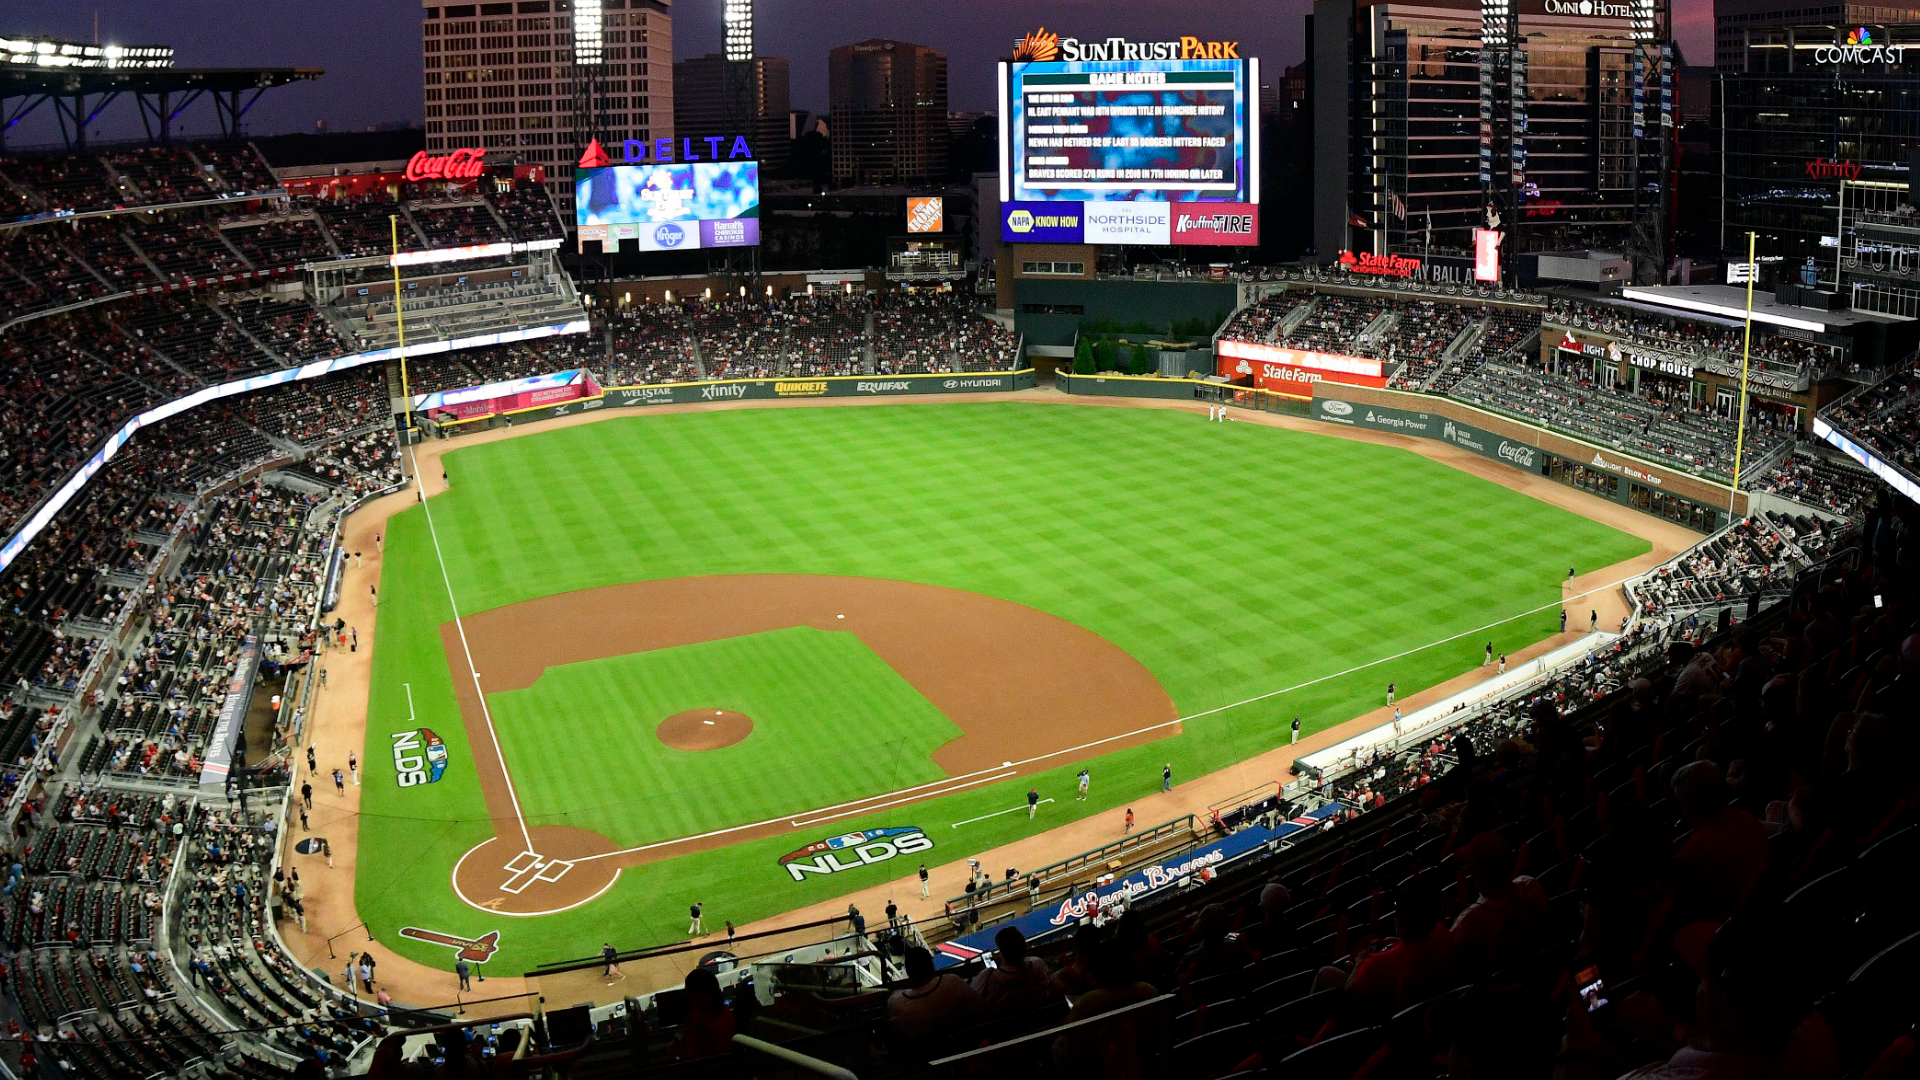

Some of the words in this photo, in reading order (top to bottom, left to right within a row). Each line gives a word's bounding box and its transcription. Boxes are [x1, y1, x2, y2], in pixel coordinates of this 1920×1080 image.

[1545, 0, 1578, 15] OMNI
[1180, 36, 1239, 59] PARK
[1815, 47, 1905, 65] COMCAST
[1089, 73, 1124, 85] GAME
[1126, 72, 1166, 84] NOTES
[1052, 106, 1080, 116] PENNANT
[1138, 106, 1154, 116] TITLE
[1155, 106, 1162, 115] IN
[1162, 106, 1197, 115] FRANCHISE
[1198, 105, 1225, 115] HISTORY
[623, 135, 752, 162] DELTA
[1063, 138, 1092, 147] RETIRED
[1102, 138, 1112, 147] OF
[1112, 138, 1129, 147] LAST
[1140, 137, 1172, 147] DODGERS
[1173, 137, 1202, 147] HITTERS
[1203, 137, 1225, 147] FACED
[406, 148, 486, 181] Coca-Cola
[1805, 157, 1862, 181] xfinity
[1028, 169, 1055, 178] BRAVES
[1055, 169, 1082, 178] SCORED
[1116, 169, 1124, 178] IN
[1142, 169, 1150, 178] IN
[1164, 169, 1189, 179] INNING
[1201, 170, 1223, 179] LATER
[908, 198, 942, 231] HOME
[1011, 216, 1030, 226] NAPA
[1035, 216, 1059, 227] KNOW
[1060, 216, 1078, 228] HOW
[1088, 215, 1166, 225] NORTHSIDE
[1213, 215, 1252, 233] TIRE
[656, 227, 683, 245] Kroger
[1359, 252, 1389, 266] State
[1389, 254, 1421, 270] Farm
[1350, 265, 1412, 277] NEIGHBORHOOD
[1433, 265, 1461, 283] BALL
[1583, 344, 1605, 357] LIGHT
[1262, 363, 1292, 380] State
[1292, 368, 1322, 384] Farm
[1630, 354, 1656, 368] CHOP
[1660, 361, 1694, 378] HOUSE
[775, 382, 828, 392] QUIKRETE
[857, 381, 911, 393] EQUIFAX
[960, 379, 1002, 387] HYUNDAI
[621, 388, 671, 398] WELLSTAR
[701, 383, 747, 400] xfinity
[1772, 389, 1792, 399] BULLET
[1328, 402, 1347, 413] Ford
[1377, 415, 1404, 427] Georgia
[1405, 420, 1427, 430] Power
[1498, 440, 1535, 467] Coca-Cola
[223, 693, 240, 712] HOME
[221, 712, 232, 720] OF
[217, 720, 230, 732] THE
[209, 733, 228, 758] BRAVES
[391, 730, 428, 787] NLDS
[808, 843, 825, 851] 20
[785, 832, 934, 881] NLDS
[1050, 879, 1148, 925] Atlanta
[1143, 849, 1224, 889] Braves
